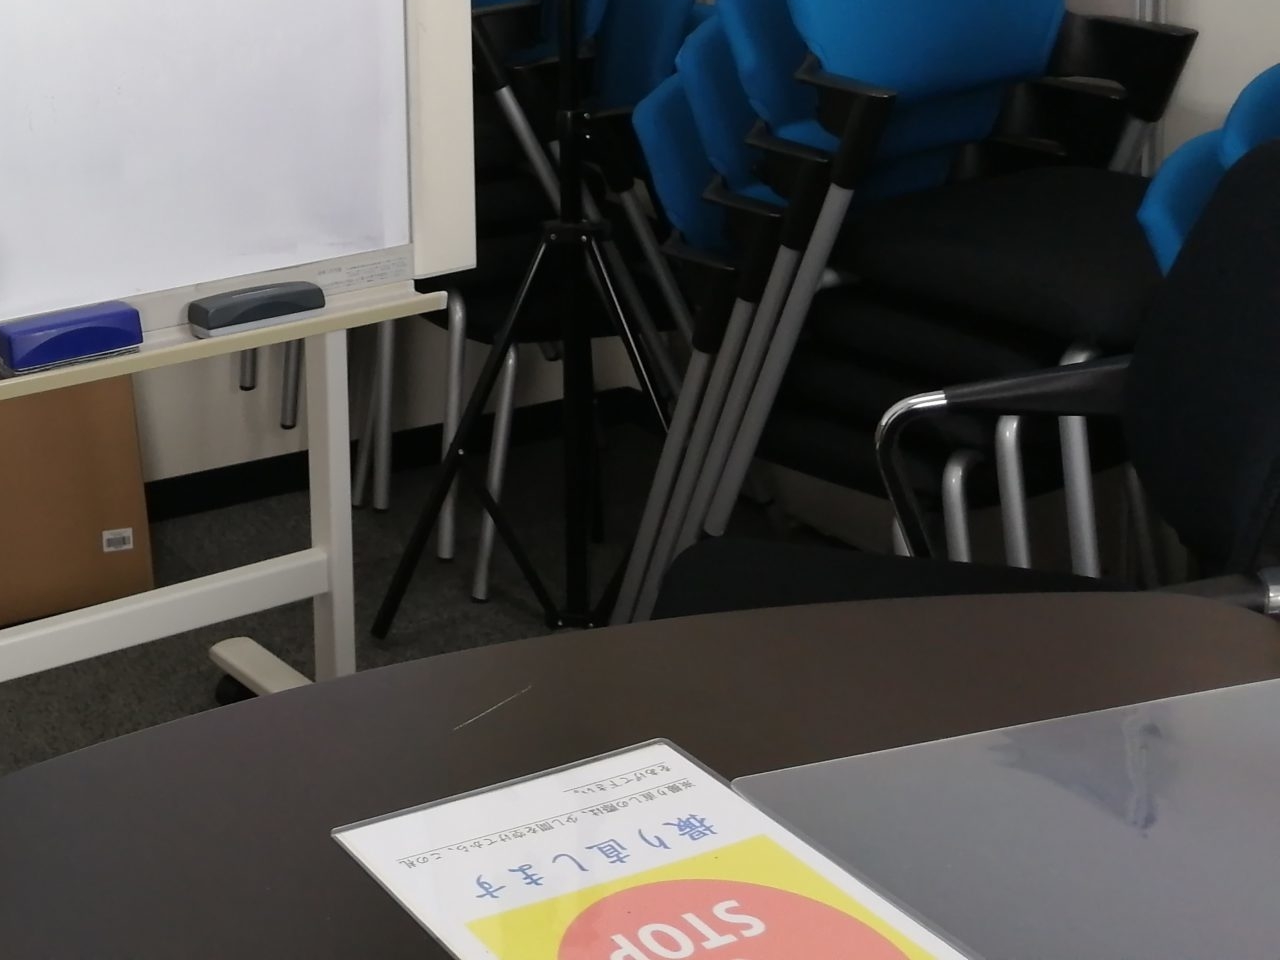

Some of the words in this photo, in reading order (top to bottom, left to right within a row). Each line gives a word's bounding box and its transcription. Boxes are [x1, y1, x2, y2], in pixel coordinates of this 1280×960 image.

[475, 813, 721, 900] 撮り直します
